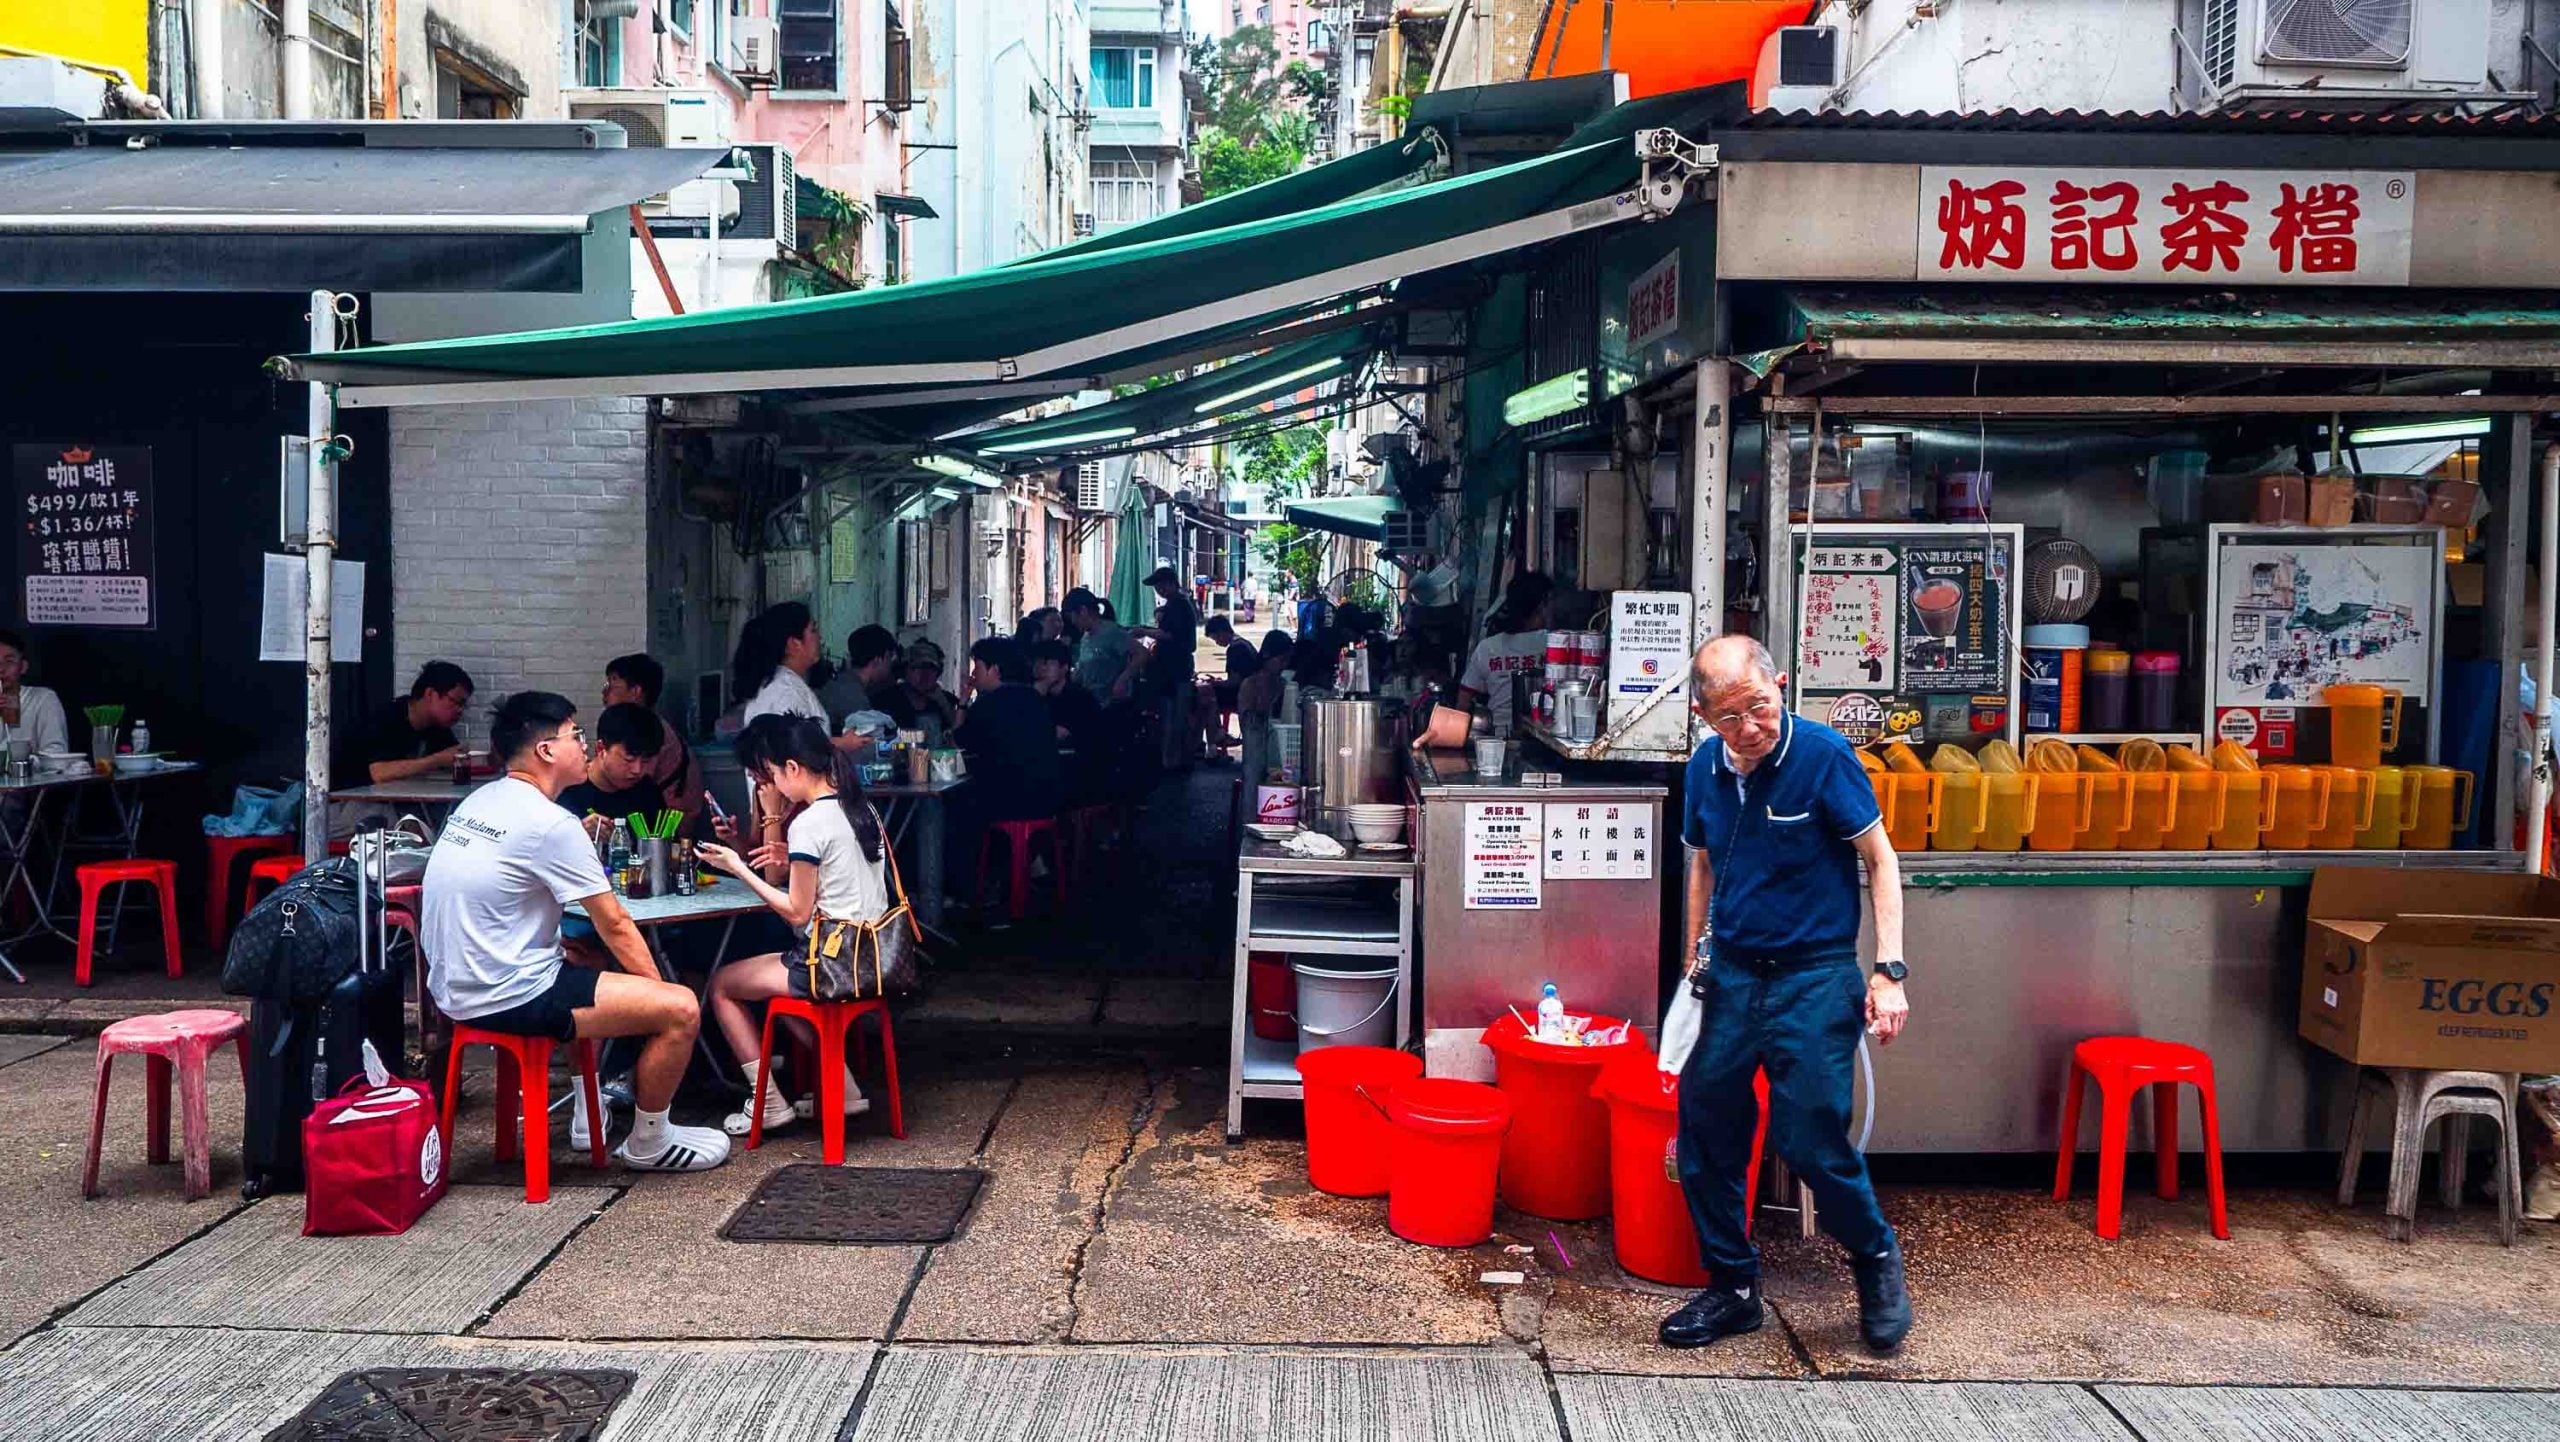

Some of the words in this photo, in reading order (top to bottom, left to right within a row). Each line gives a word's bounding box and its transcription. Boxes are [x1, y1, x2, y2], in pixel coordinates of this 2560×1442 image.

[1938, 178, 2361, 273] 炳記茶檔
[47, 458, 115, 489] 咖啡
[27, 490, 139, 514] $499/飲1年
[40, 515, 131, 535] $1.36/杯!
[1814, 553, 1884, 567] 炳記茶檔
[1625, 602, 1679, 616] 繁忙時間
[1489, 655, 1543, 671] 炳記茶
[2418, 978, 2556, 1018] EGGS
